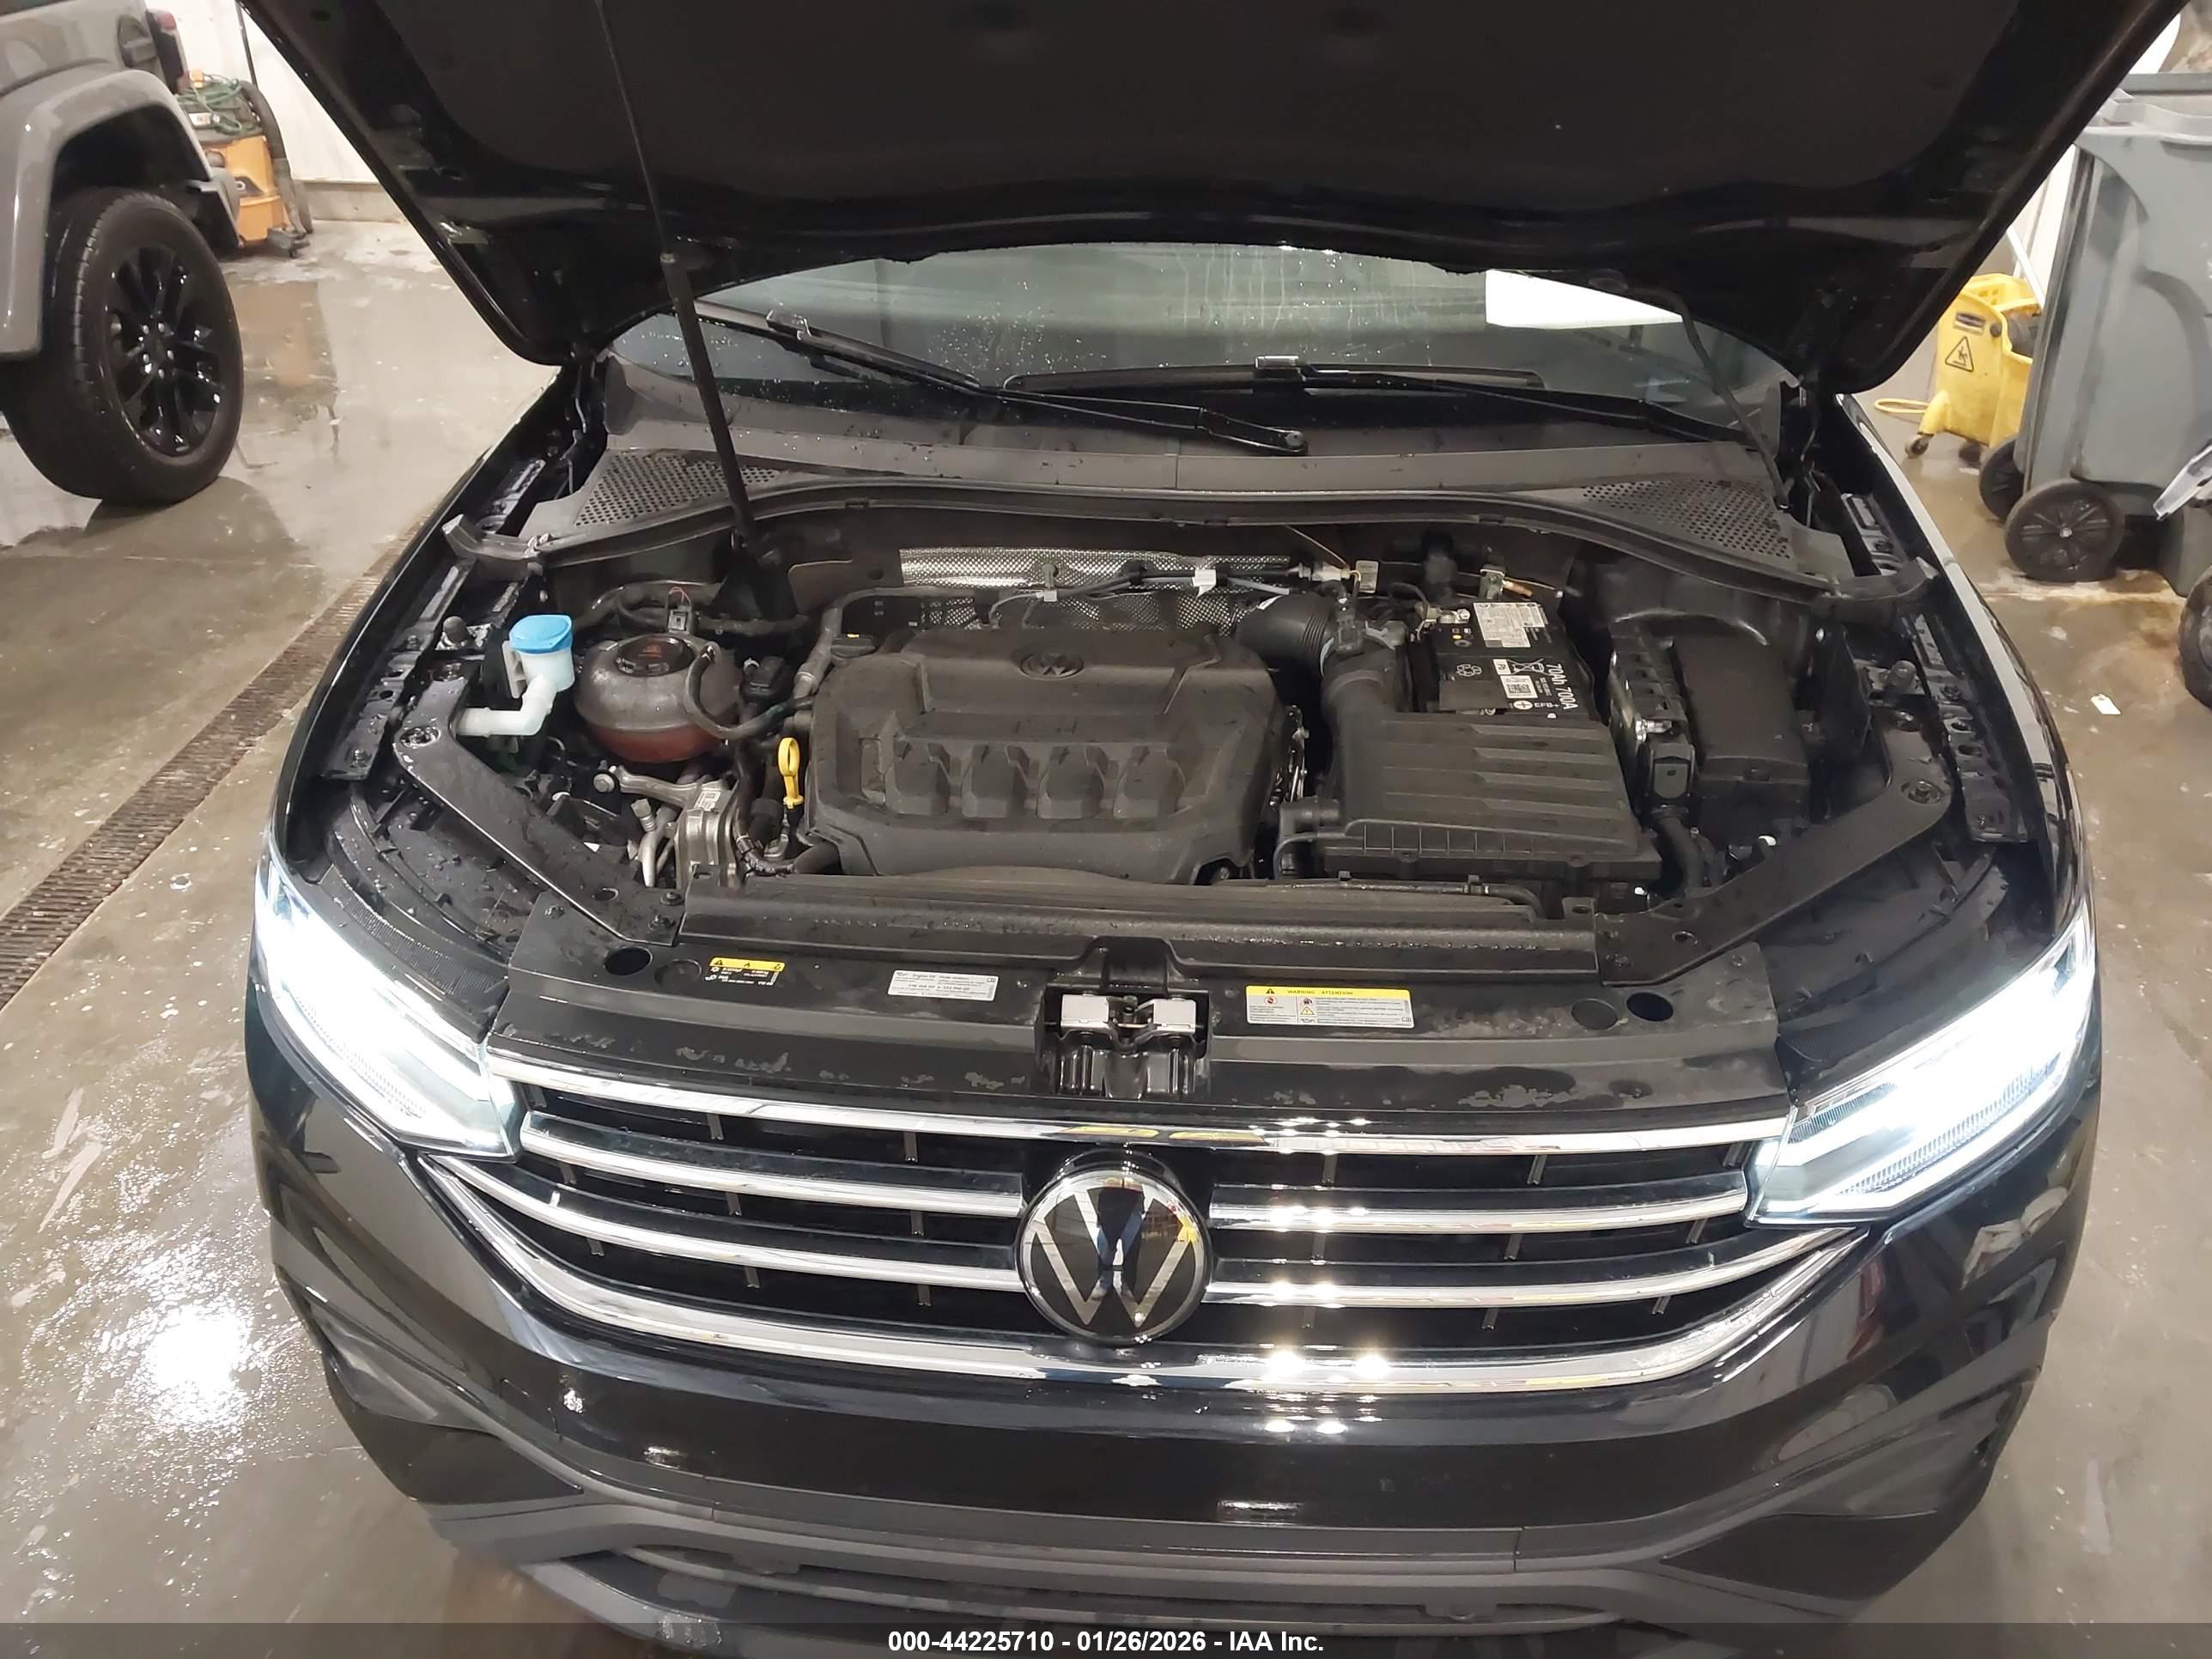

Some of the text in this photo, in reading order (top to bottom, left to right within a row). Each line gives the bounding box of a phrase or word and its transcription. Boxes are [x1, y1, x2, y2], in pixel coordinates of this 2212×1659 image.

[1546, 663, 1579, 710] 70Ah 700A
[1022, 1171, 1204, 1336] VW
